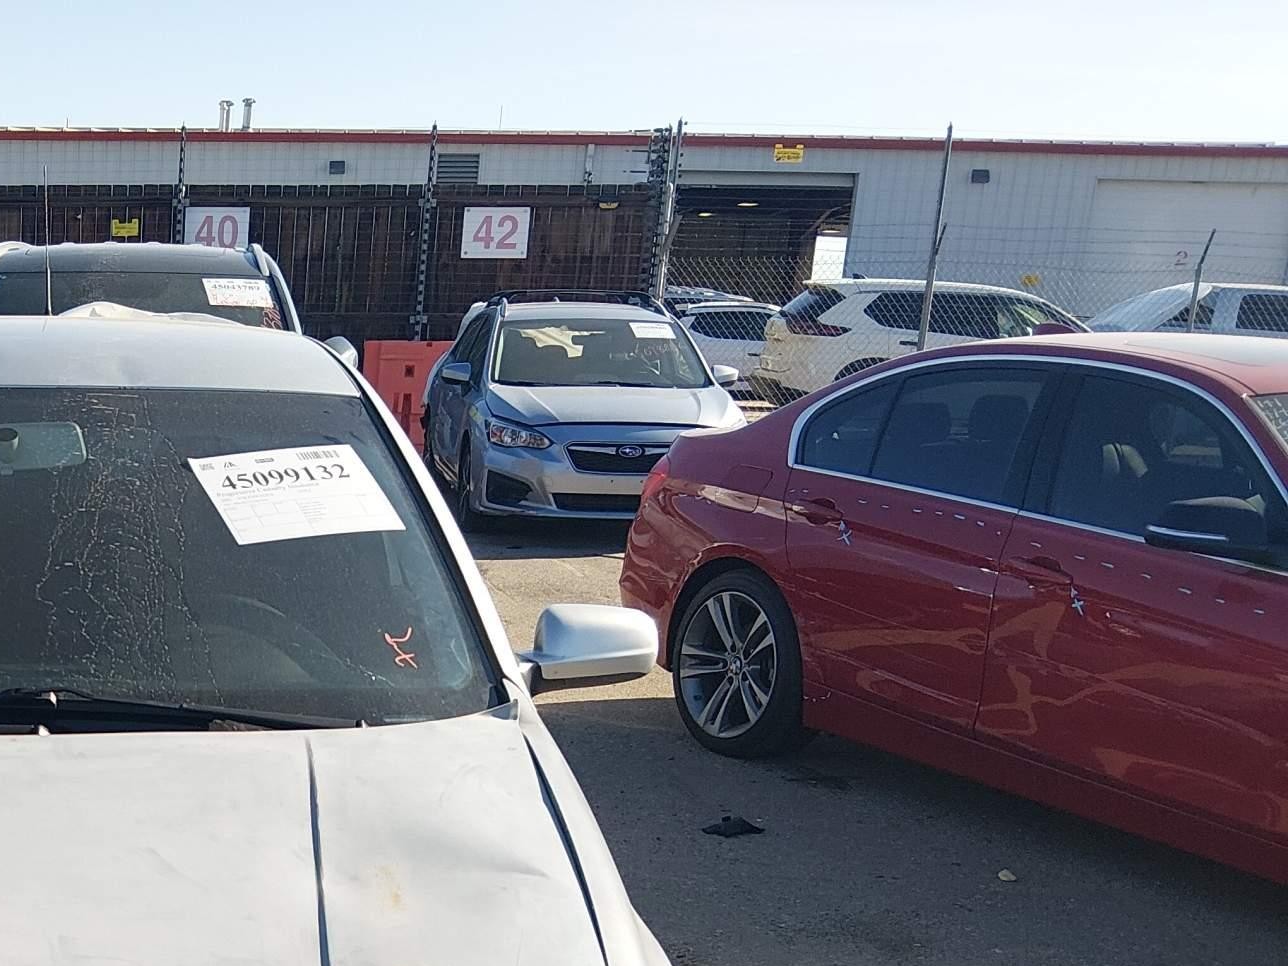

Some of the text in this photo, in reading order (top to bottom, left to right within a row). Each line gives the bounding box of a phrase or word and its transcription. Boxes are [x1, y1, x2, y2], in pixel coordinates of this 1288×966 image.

[194, 215, 239, 249] 40
[472, 214, 520, 250] 42
[221, 463, 350, 490] 45099132
